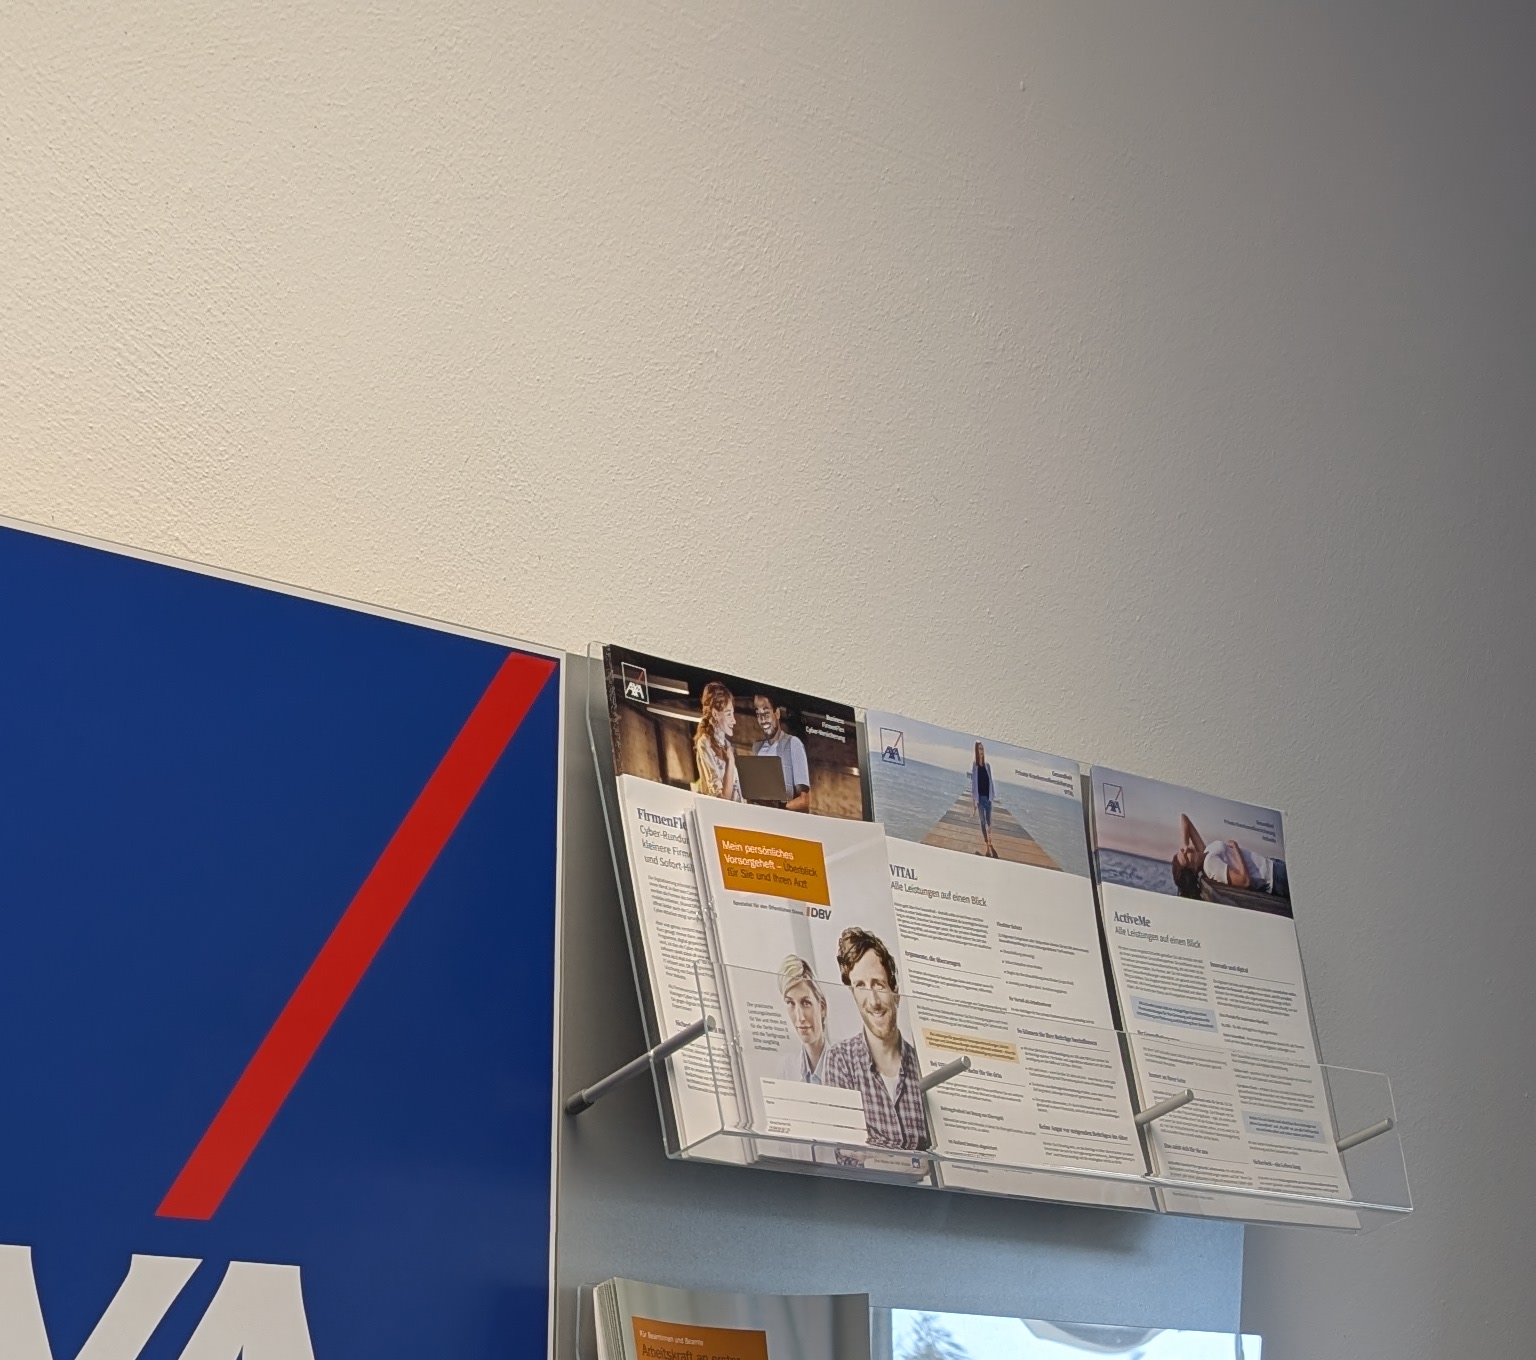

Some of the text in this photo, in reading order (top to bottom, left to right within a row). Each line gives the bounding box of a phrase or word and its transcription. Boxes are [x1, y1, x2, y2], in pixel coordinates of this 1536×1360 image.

[636, 807, 687, 831] FirmenFle
[721, 840, 794, 861] Mein persönliches
[723, 853, 776, 870] Vorsorgeheft
[783, 860, 818, 878] Überblick
[889, 863, 918, 881] VITAL
[726, 867, 739, 877] für
[740, 868, 755, 880] Sie
[756, 871, 771, 882] und
[772, 875, 793, 886] Ihren
[890, 881, 987, 907] Alle Leistungen auf einen Blick
[810, 907, 832, 921] DBV
[1113, 911, 1152, 928] ActiveMe
[1114, 926, 1202, 949] Alle Leistungen auf einen Blick
